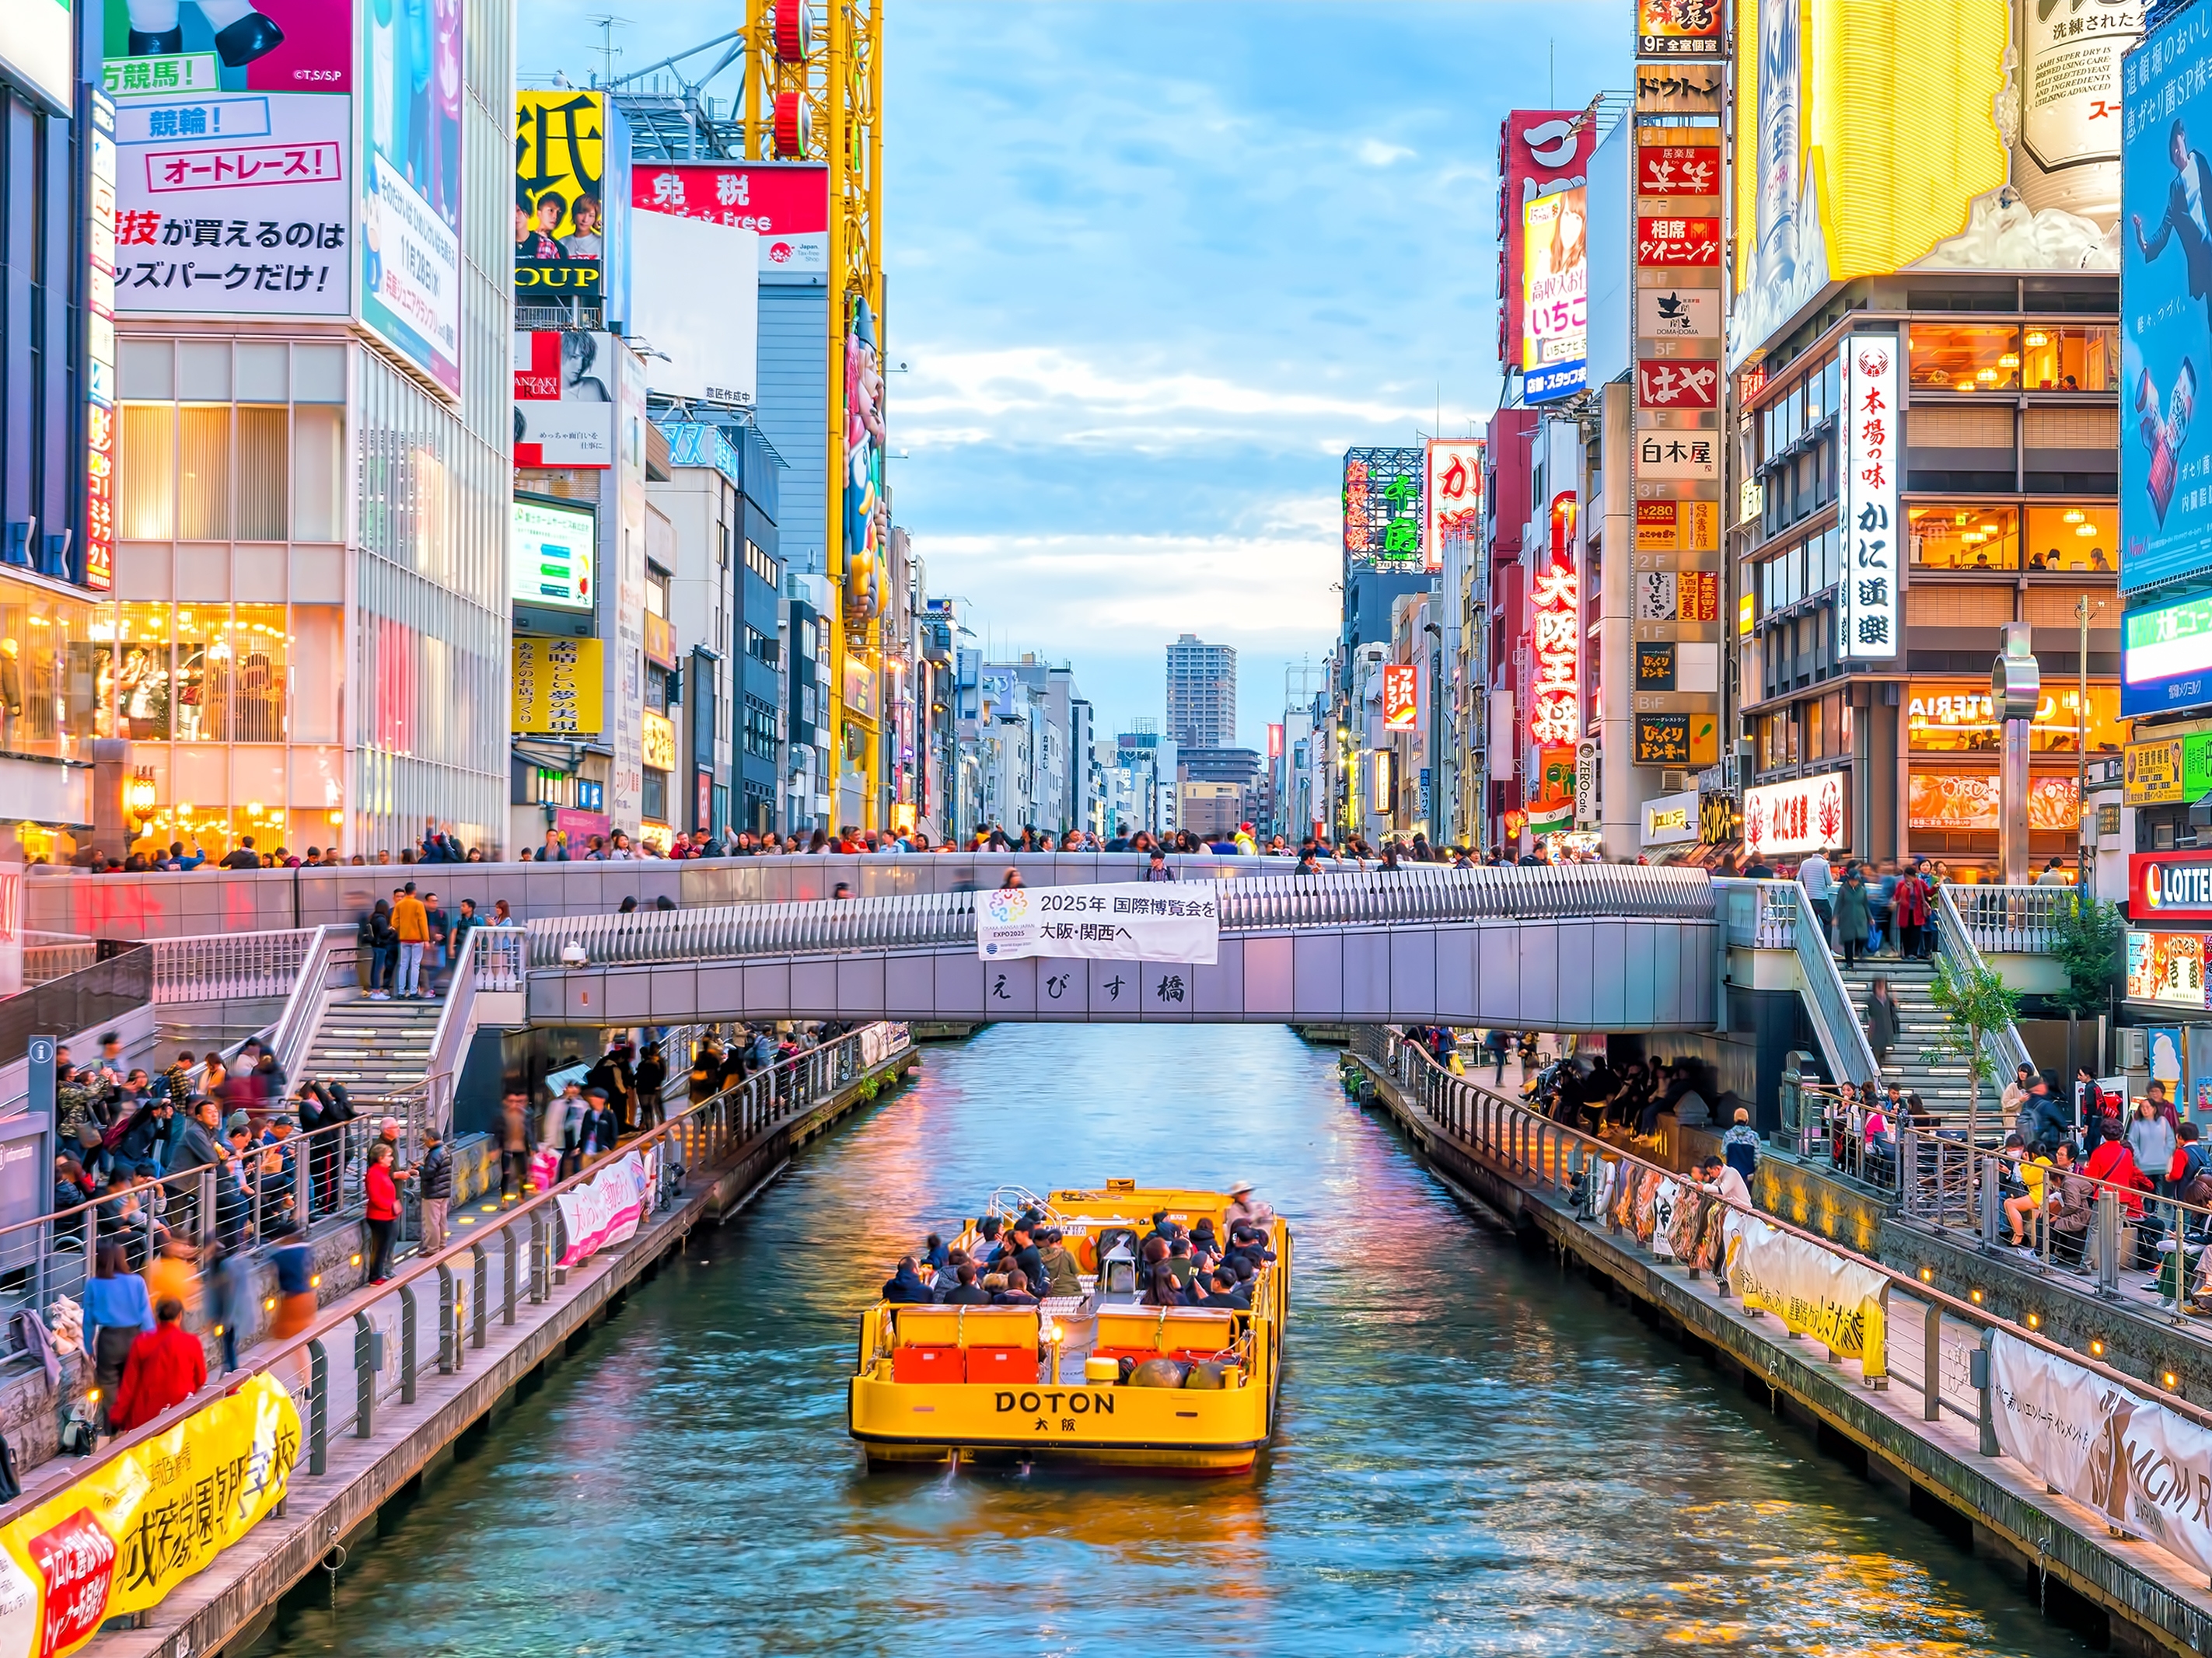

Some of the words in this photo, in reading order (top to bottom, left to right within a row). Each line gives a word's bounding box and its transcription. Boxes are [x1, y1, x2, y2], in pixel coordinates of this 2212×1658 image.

[1644, 36, 1664, 52] 9F
[1667, 39, 1717, 52] 全室個室
[2036, 58, 2055, 72] ASAHI
[2056, 51, 2081, 64] SUPER
[2083, 47, 2101, 58] DRY
[2036, 66, 2061, 81] BREWED
[2062, 59, 2084, 71] USING
[2087, 56, 2112, 65] CARE-
[2035, 76, 2053, 90] FULLY
[2053, 68, 2087, 82] SELECTED
[2087, 65, 2111, 74] YEAST
[2035, 89, 2050, 99] AND
[2050, 74, 2111, 92] INGREDIENTS
[2035, 90, 2067, 108] UTILISING
[2067, 83, 2111, 97] ADVANCED
[149, 106, 221, 137] 競輪!
[164, 148, 323, 184] オートレース!
[1651, 220, 1686, 239] 相席
[1640, 239, 1718, 262] ダイニング
[515, 267, 599, 287] OUP
[1655, 342, 1676, 355] 5F
[706, 386, 751, 403] 意匠作成中
[1859, 386, 1886, 490] 本場の味
[1641, 438, 1712, 466] 白木屋
[1529, 564, 1578, 744] 大阪王将
[1642, 655, 1669, 667] びっくり
[519, 642, 535, 724] あなたのお店づくり
[1641, 667, 1671, 678] ドンキー
[548, 641, 578, 731] 素晴らしい夢の実現
[1386, 674, 1400, 714] ドラッグ
[1400, 668, 1414, 706] ツルハ
[1642, 724, 1684, 742] びっくり
[1640, 742, 1686, 759] ドンキー
[2164, 868, 2212, 902] LOTTE
[1040, 895, 1106, 913] 2025年
[1113, 896, 1216, 918] 国際博覧会を
[1040, 922, 1133, 941] 大阪・関西へ
[992, 972, 1185, 1004] えびす橋
[995, 1391, 1115, 1414] DOTON
[1035, 1417, 1077, 1432] 大阪
[2126, 1440, 2193, 1514] MGM
[2134, 1496, 2164, 1537] JAPAN
